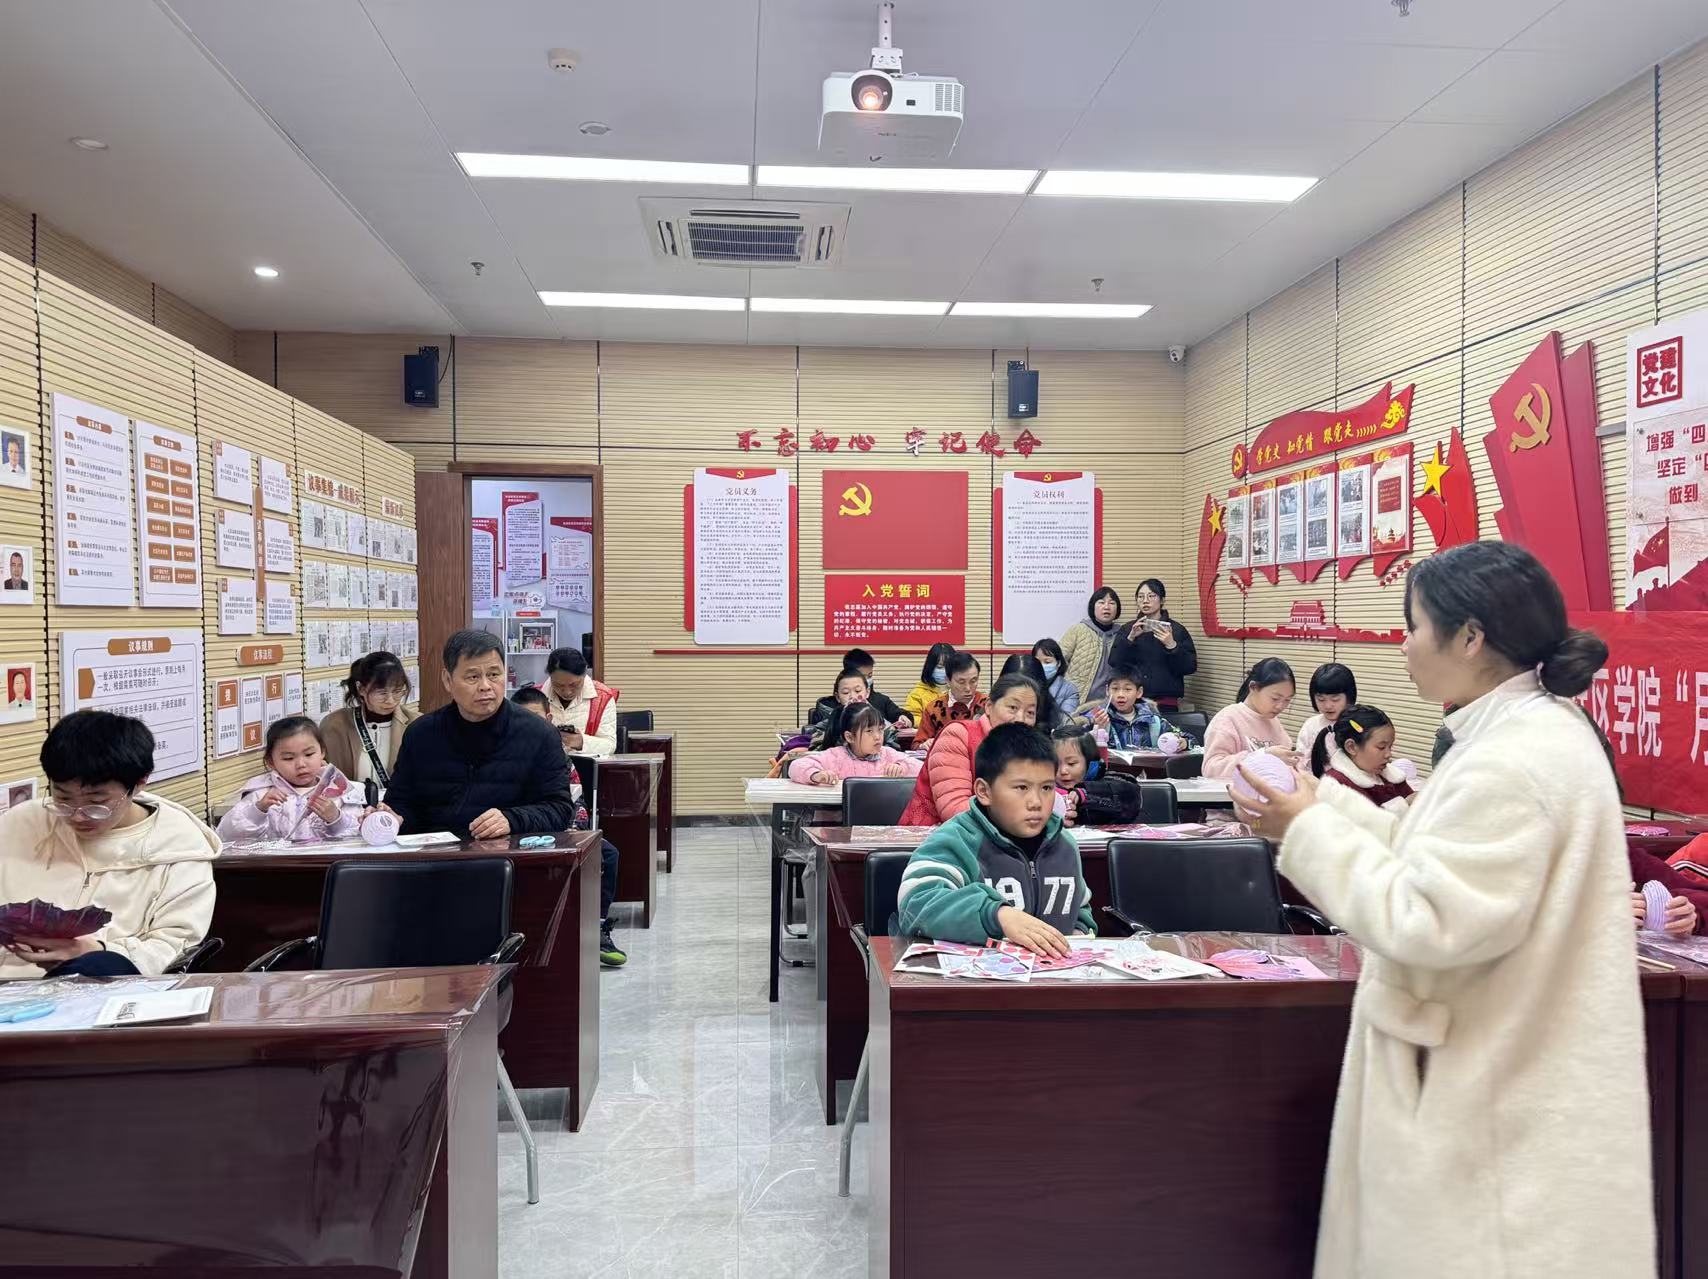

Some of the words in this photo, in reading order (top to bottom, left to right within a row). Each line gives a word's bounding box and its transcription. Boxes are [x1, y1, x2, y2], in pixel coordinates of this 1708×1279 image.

[1642, 346, 1677, 376] 党建
[1642, 371, 1677, 398] 文化
[736, 427, 876, 458] 不忘初心
[905, 426, 1042, 459] 牢记使命
[1657, 452, 1708, 478] 坚定“
[1669, 483, 1699, 504] 做到
[862, 583, 931, 599] 入党誓词
[128, 639, 155, 653] 议事规则
